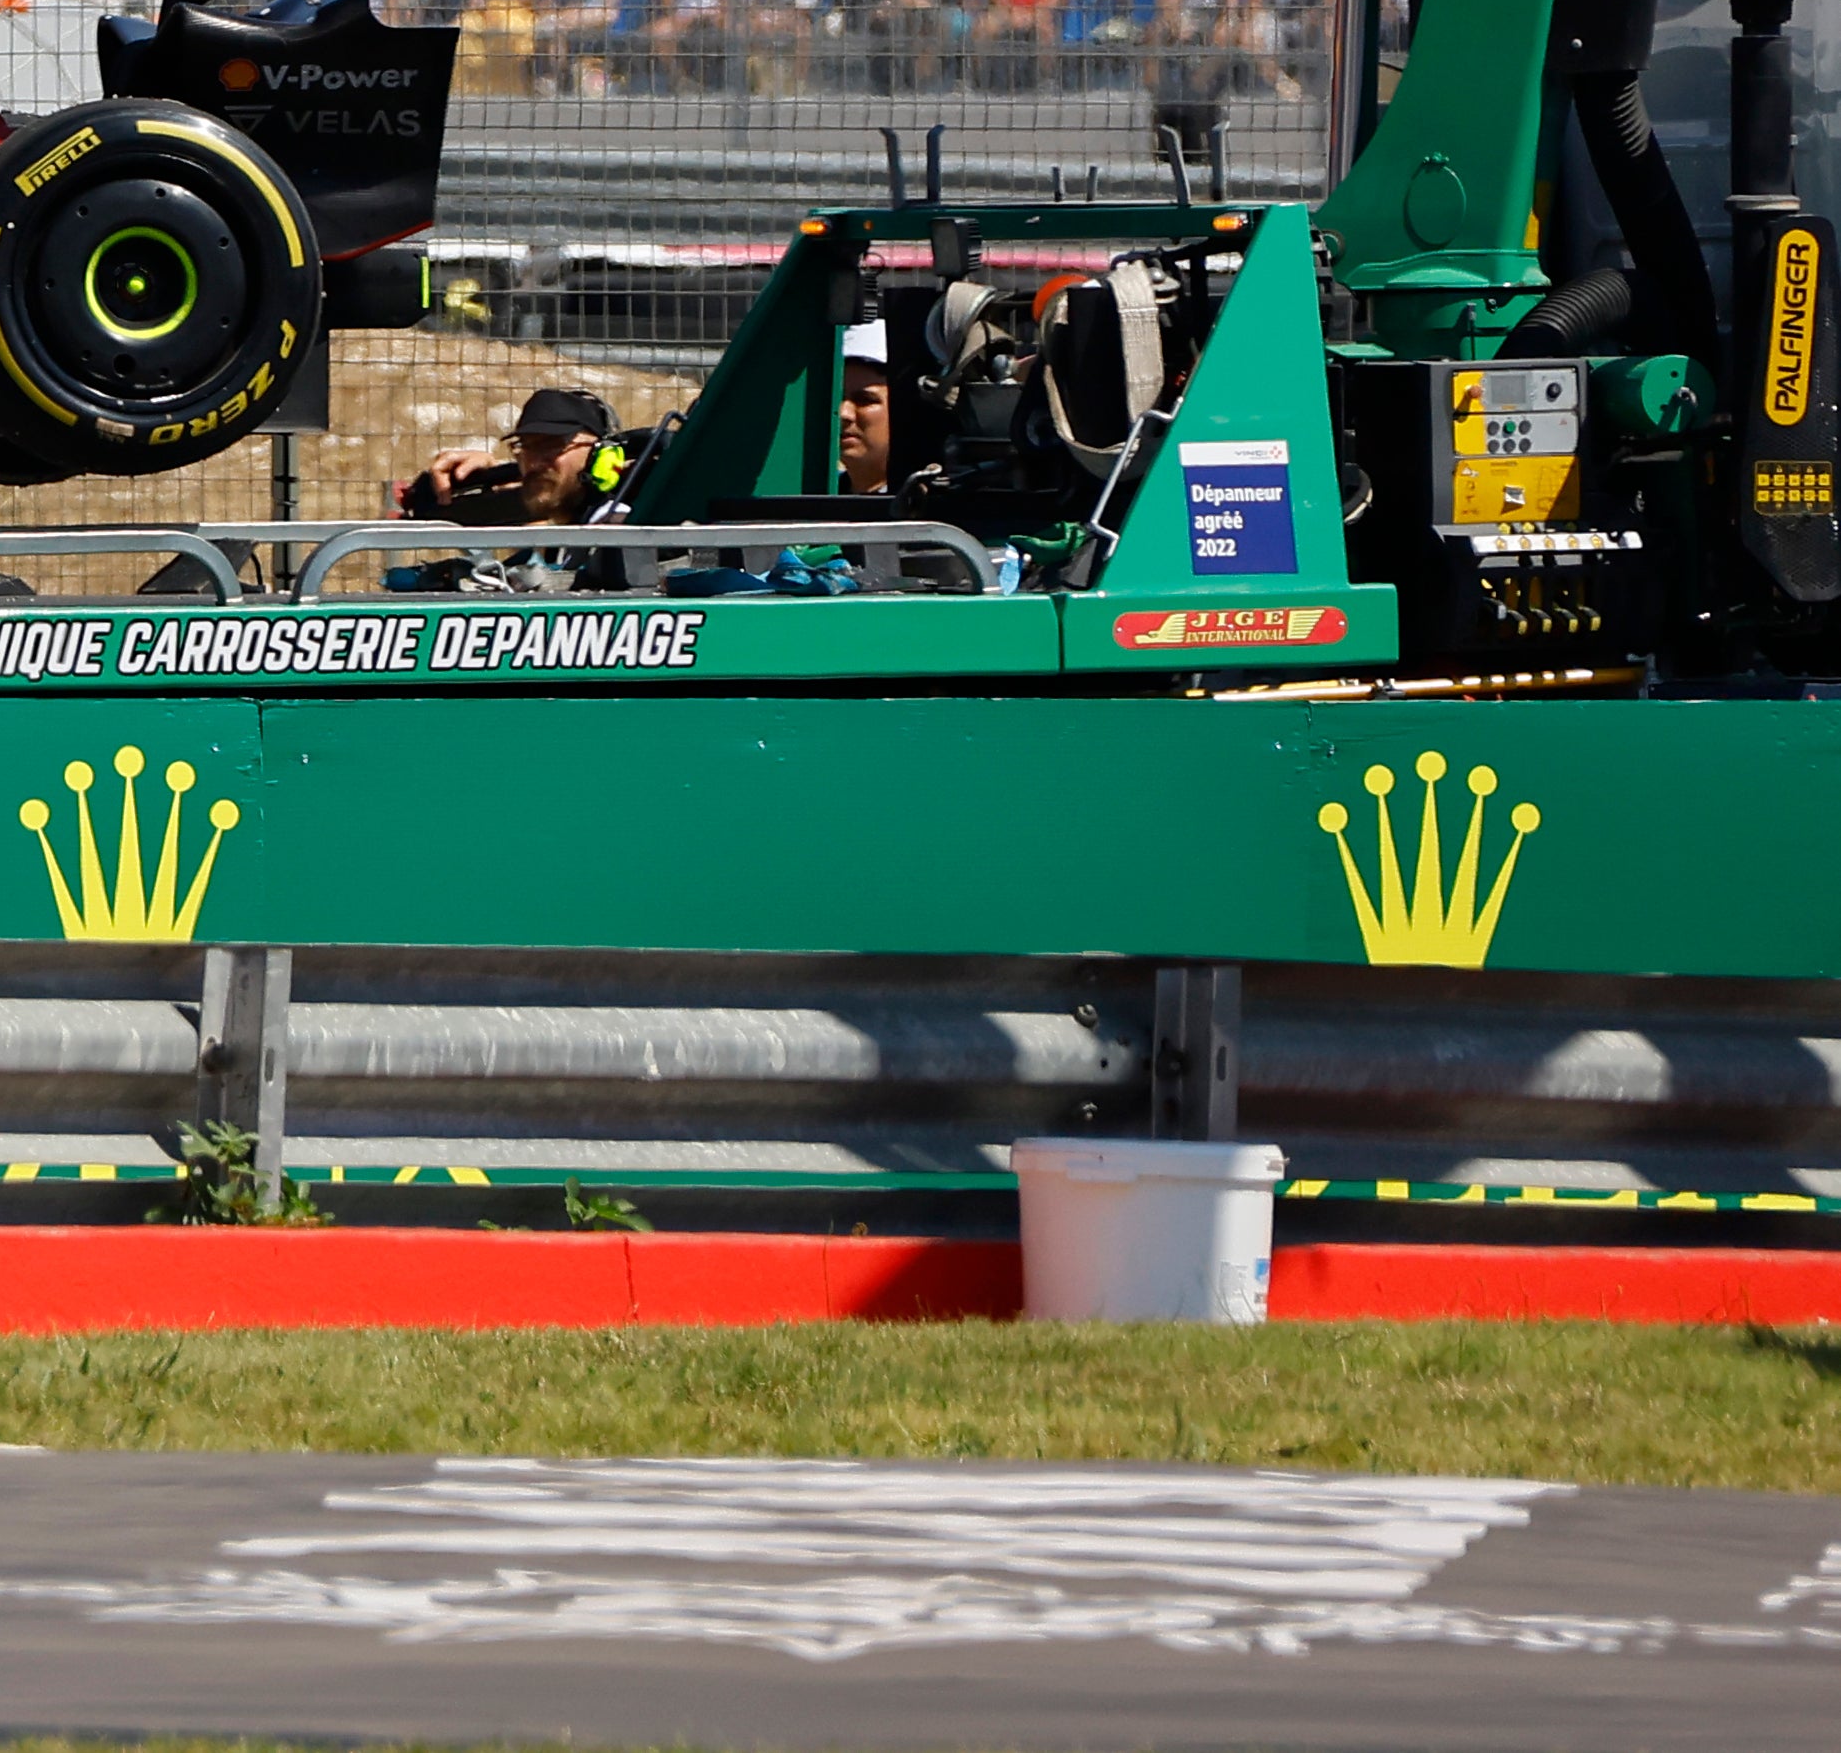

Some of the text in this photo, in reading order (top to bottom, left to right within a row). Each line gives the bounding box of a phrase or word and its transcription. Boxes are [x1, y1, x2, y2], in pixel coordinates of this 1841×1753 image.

[262, 64, 418, 90] V-Power
[285, 109, 421, 137] VELAS
[13, 126, 102, 197] PIRELLI
[1775, 242, 1810, 412] PALFINGER
[148, 361, 275, 445] ZERO
[1191, 483, 1284, 506] Dépanneur
[1194, 510, 1244, 535] agréé
[1197, 538, 1238, 557] 2022
[1190, 610, 1284, 627] JIGE
[119, 617, 425, 673] CARROSSERIE
[429, 613, 703, 670] DEPANNAGE
[1186, 629, 1285, 643] INTERNATIONAL
